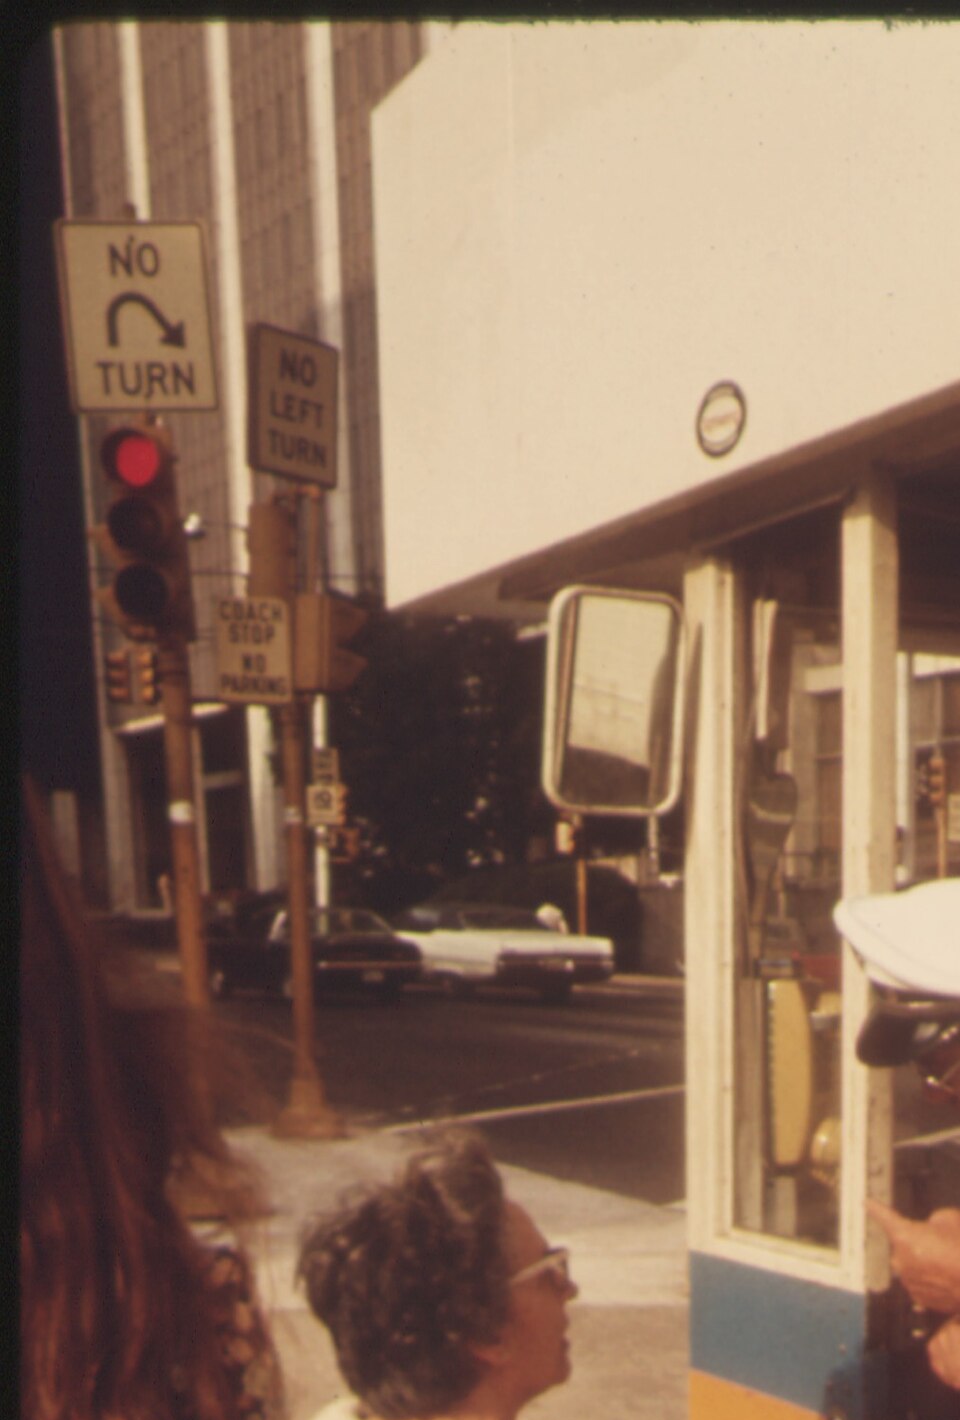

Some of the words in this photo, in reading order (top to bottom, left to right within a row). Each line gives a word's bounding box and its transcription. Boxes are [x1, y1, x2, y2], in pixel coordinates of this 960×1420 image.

[108, 241, 160, 278] NO
[96, 361, 196, 397] TURN
[279, 347, 317, 388] NO
[269, 385, 325, 429] LEFT
[269, 429, 326, 467] TURN
[220, 601, 282, 620] COACH
[228, 621, 276, 644] STOP
[242, 653, 267, 671] NO
[220, 672, 287, 695] PARKING
